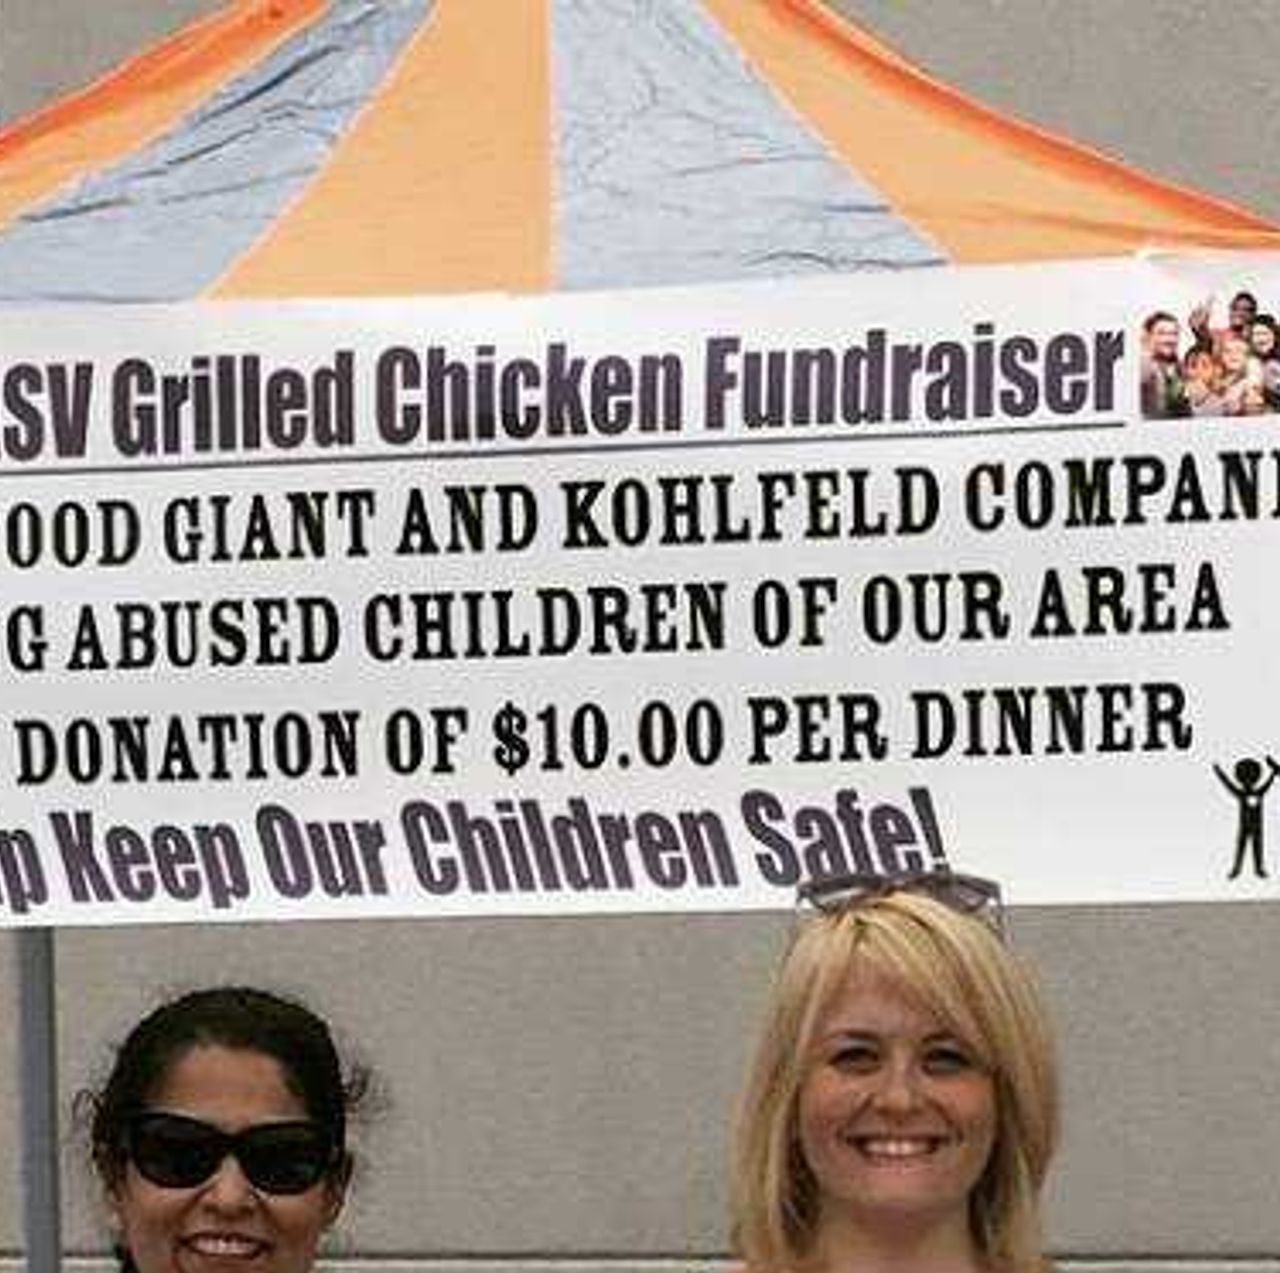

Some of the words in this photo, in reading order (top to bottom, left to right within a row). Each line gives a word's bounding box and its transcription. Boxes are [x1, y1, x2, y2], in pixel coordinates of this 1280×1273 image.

[112, 350, 355, 458] Grilled
[376, 343, 682, 446] Chicken
[705, 323, 1125, 435] Fundraiser
[163, 488, 376, 565] GIANT
[395, 483, 539, 556] AND
[559, 466, 940, 550] KOHLFELD
[65, 596, 340, 671] ABUSED
[364, 581, 728, 662] CHILDREN
[753, 577, 838, 649] OF
[862, 570, 1011, 645] OUR
[1029, 561, 1231, 639] AREA
[13, 710, 361, 786] DONATION
[385, 706, 469, 776] OF
[492, 698, 725, 777] $10.00
[747, 693, 889, 765] PER
[910, 682, 1193, 760] DINNER
[48, 811, 250, 909] Keep
[255, 804, 387, 898] Our
[400, 797, 739, 895] Children
[740, 787, 946, 887] Safe!
